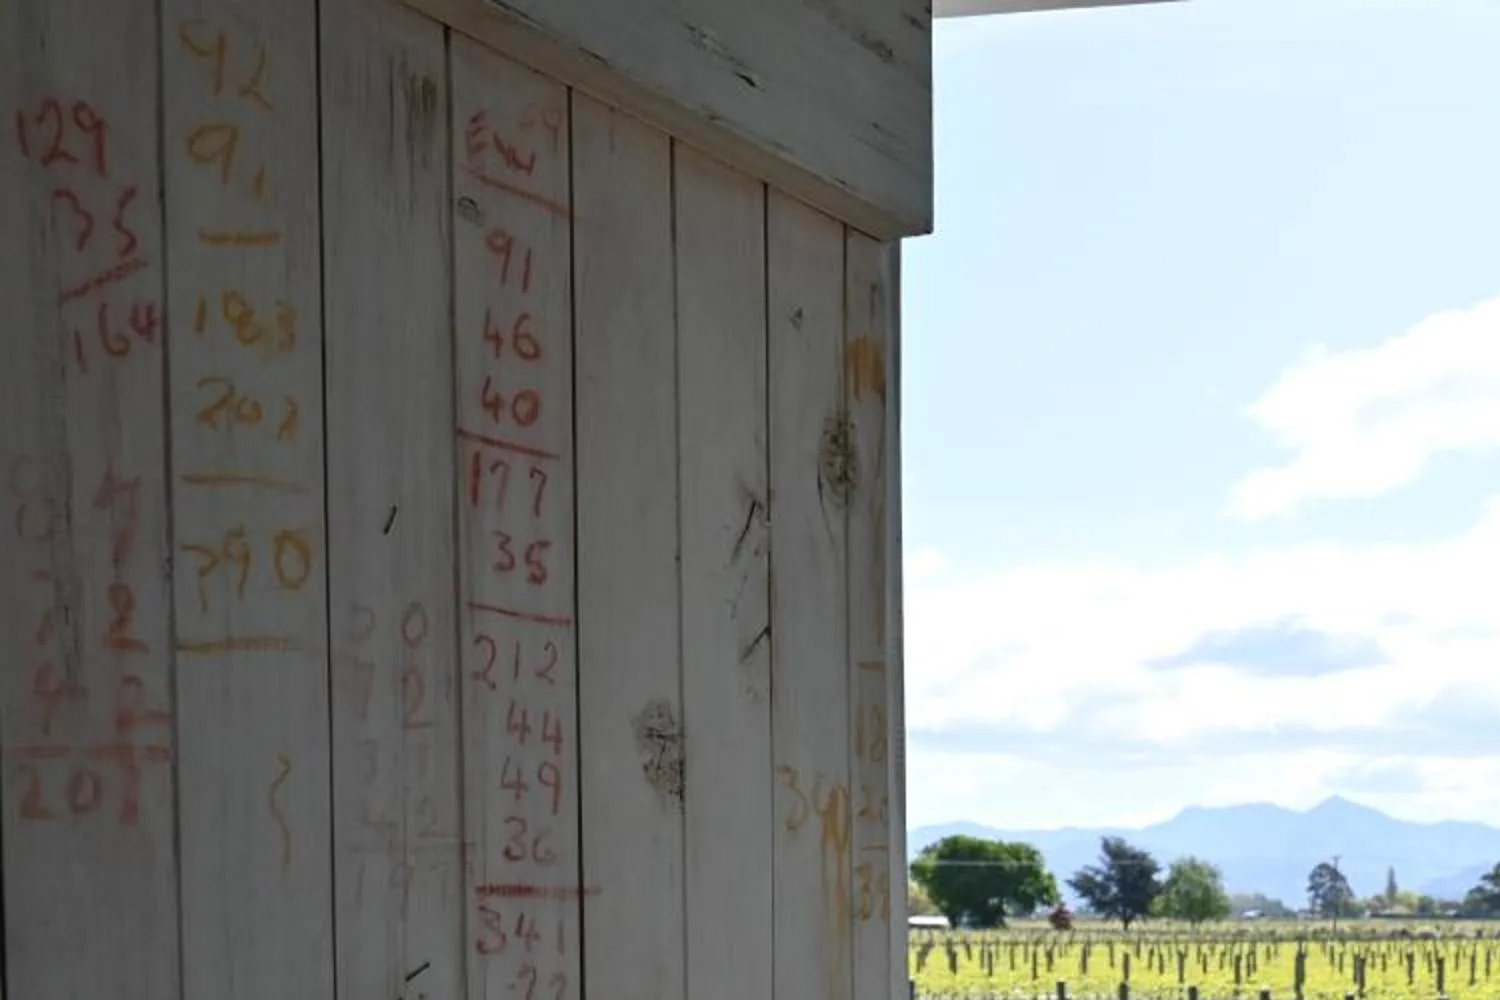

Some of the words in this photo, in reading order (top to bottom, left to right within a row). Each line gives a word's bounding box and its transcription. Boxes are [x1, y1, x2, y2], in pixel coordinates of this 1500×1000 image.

[484, 227, 532, 294] 91
[482, 305, 543, 363] 46
[480, 375, 542, 427] 40
[469, 634, 560, 691] 212
[506, 699, 563, 756] 44
[499, 755, 563, 816] 49
[502, 814, 558, 868] 36
[475, 903, 568, 956] 341
